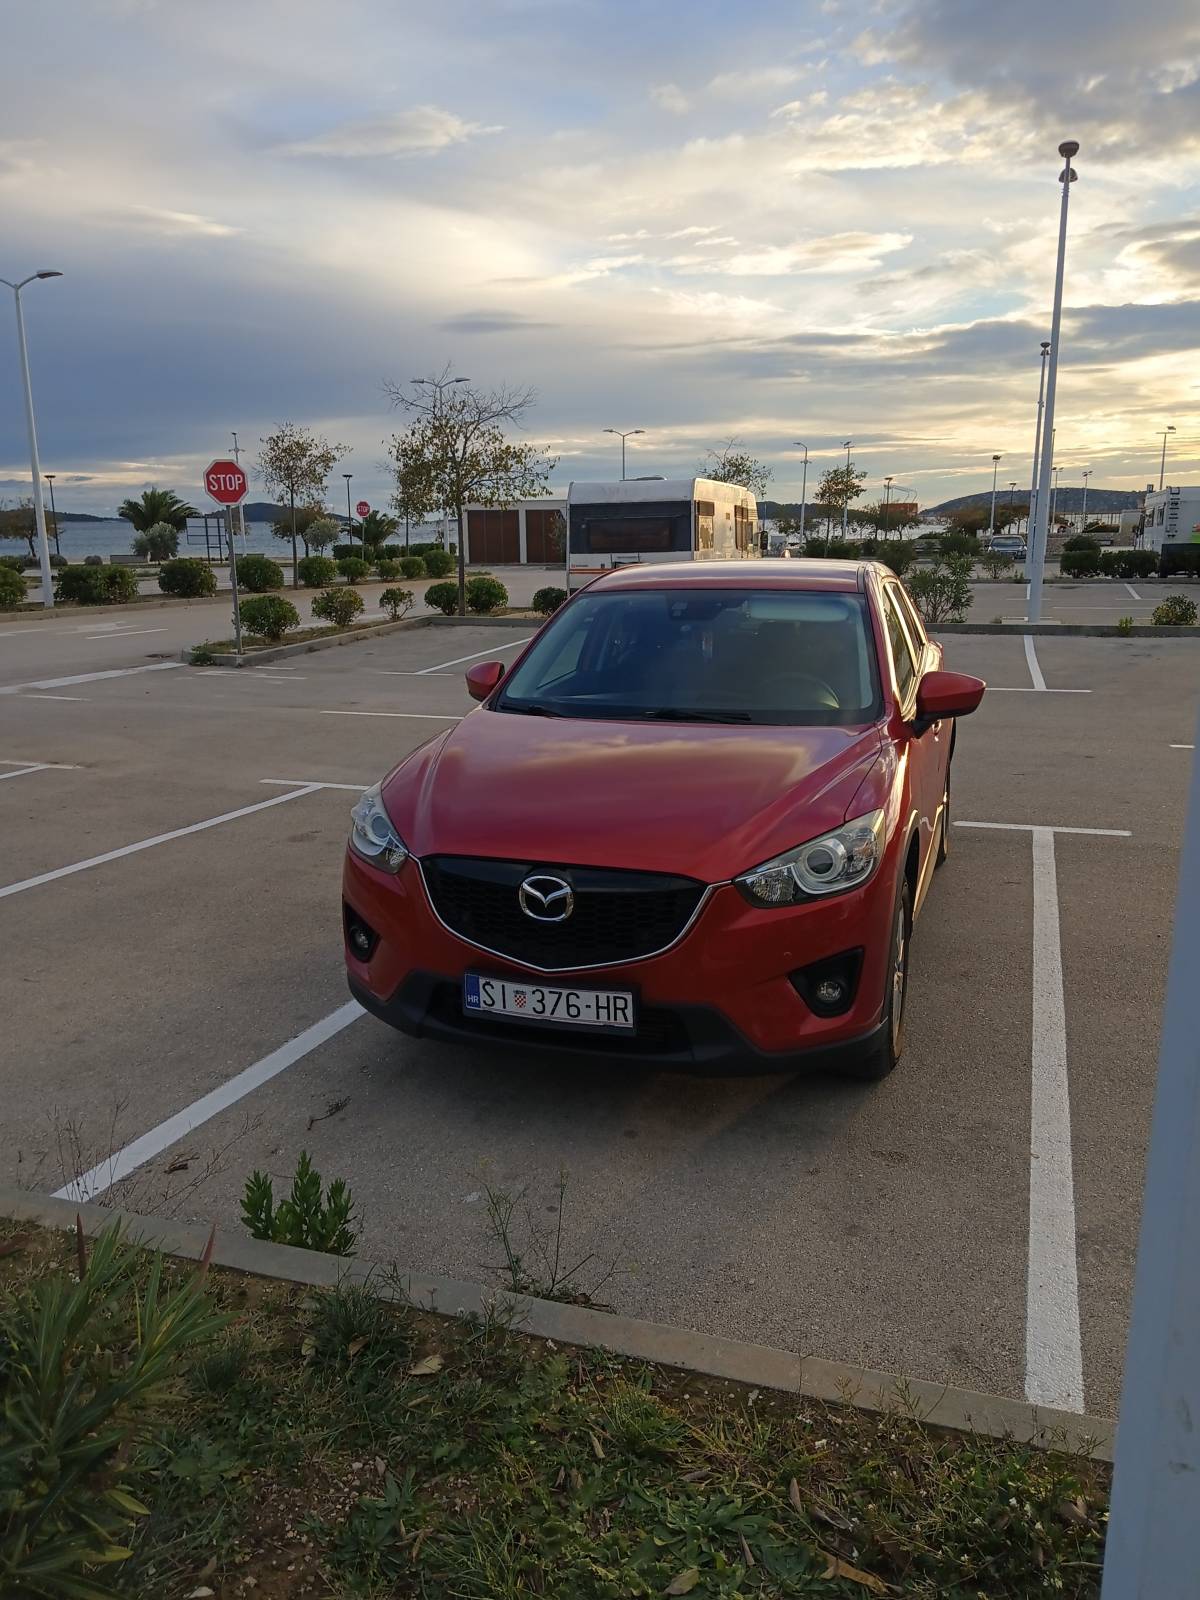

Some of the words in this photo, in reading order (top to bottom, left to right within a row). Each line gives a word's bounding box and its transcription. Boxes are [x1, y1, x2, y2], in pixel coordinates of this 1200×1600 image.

[209, 474, 243, 491] STOP
[358, 505, 370, 513] STOP
[467, 994, 479, 1004] HR
[531, 988, 629, 1023] 376-HR
